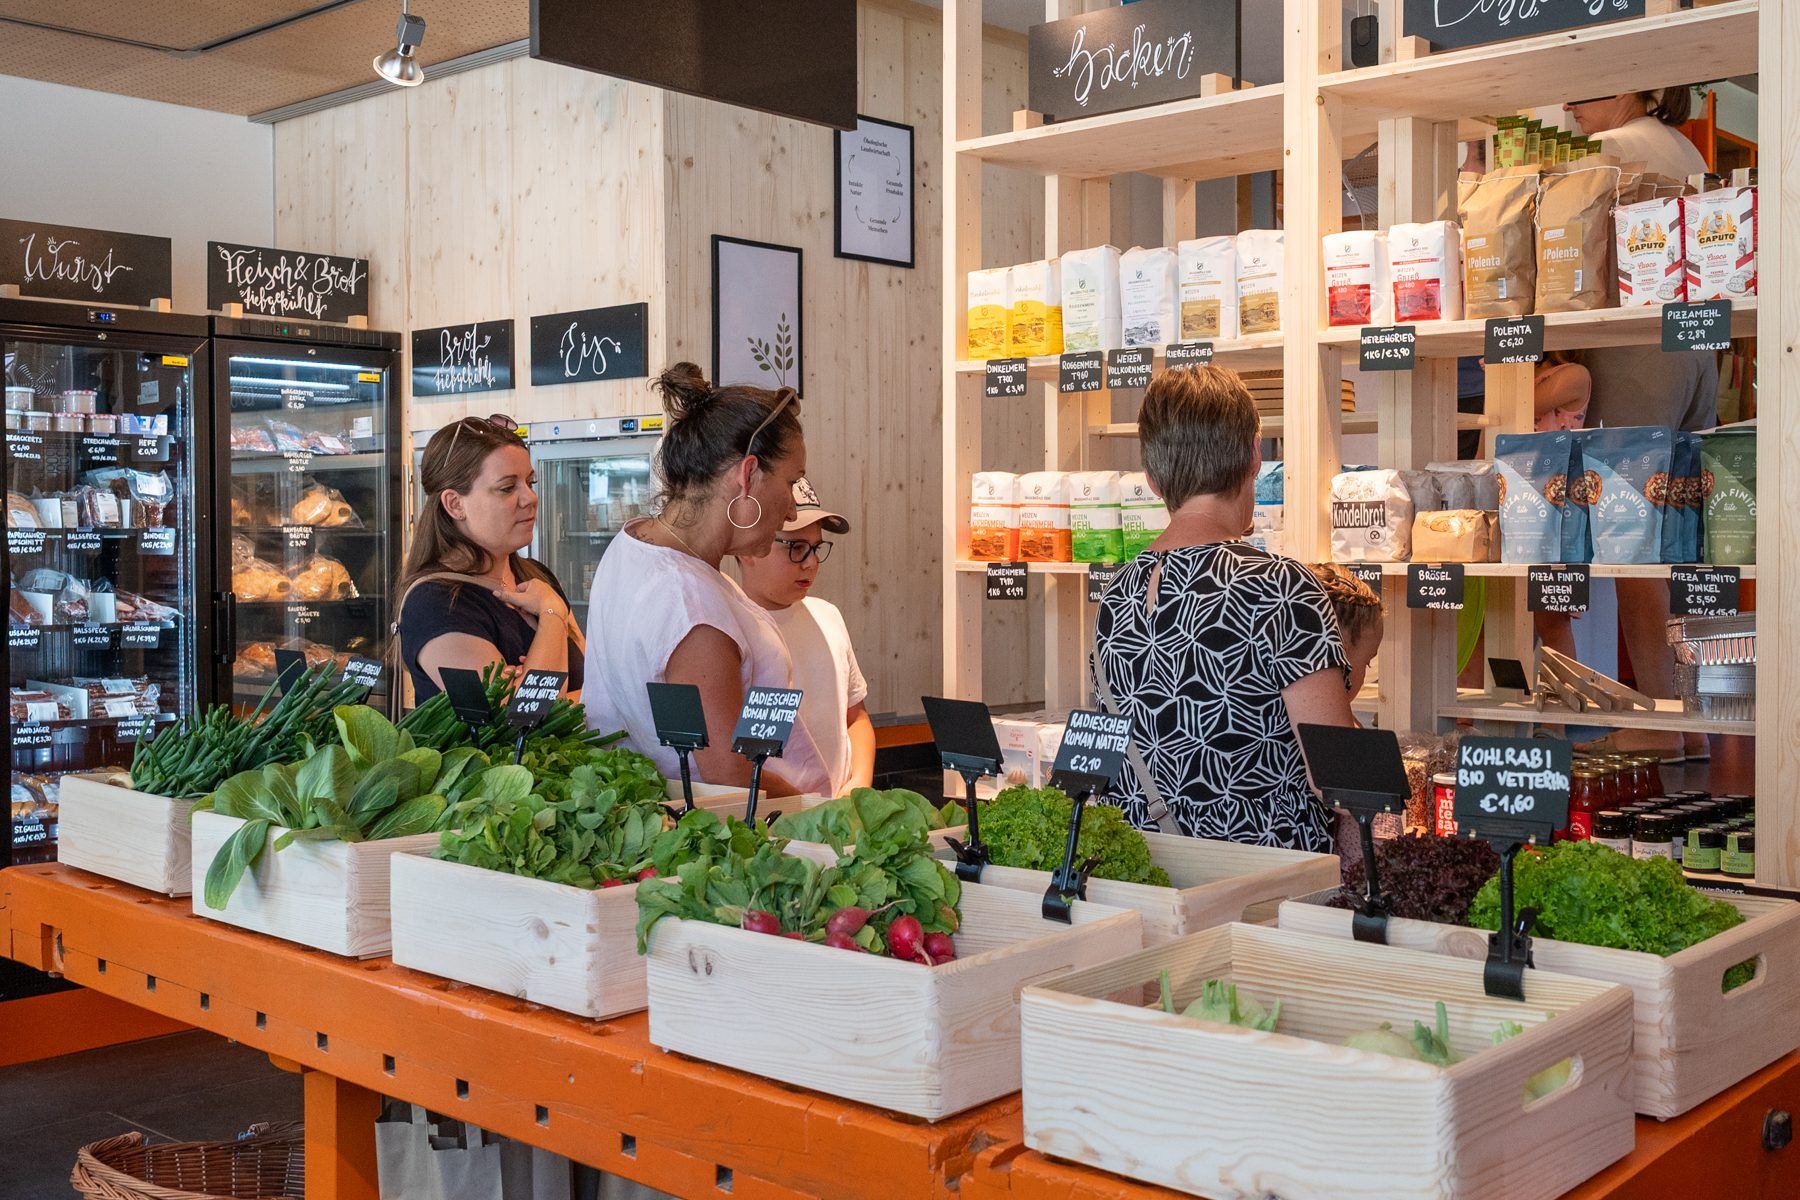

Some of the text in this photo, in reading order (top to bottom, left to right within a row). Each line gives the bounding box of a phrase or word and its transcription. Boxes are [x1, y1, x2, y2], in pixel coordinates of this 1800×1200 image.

[1699, 233, 1735, 244] CAPUTO
[1546, 246, 1579, 260] Polenta
[1629, 242, 1665, 253] CAPUTO
[20, 233, 133, 293] Wurst
[1470, 255, 1501, 268] Polenta
[218, 245, 366, 296] Fleisch & Brot
[1667, 309, 1721, 320] PIZZAMEHL
[1493, 325, 1532, 337] POLENTA
[440, 323, 491, 370] Brot
[560, 321, 622, 378] Eis
[1062, 359, 1101, 370] ROGGENMEHL
[1116, 353, 1142, 364] WEIZEN
[986, 363, 1027, 374] DINKELMEHL
[1107, 364, 1152, 376] VOLLKORNMEHL
[997, 374, 1013, 384] T700
[1071, 370, 1089, 381] T960
[1109, 376, 1147, 387] 1KG €1,99
[986, 385, 999, 395] 1KG
[1062, 382, 1075, 391] 1KG
[1503, 492, 1547, 518] PIZZA FINITO
[1598, 490, 1647, 518] PIZZA FINITO
[1708, 488, 1756, 516] PIZZA FINITO
[1333, 503, 1385, 528] Knödelbrot
[1072, 521, 1094, 531] MEHL
[1124, 521, 1148, 531] MEHL
[987, 567, 1026, 576] KUCHENMEHL
[1418, 570, 1452, 581] BRÖSEL
[1530, 571, 1585, 583] PIZZA FINITO
[1672, 571, 1737, 584] PIZZA FINITO
[988, 587, 1000, 597] 1KG
[1541, 584, 1572, 595] WEIZEN
[1687, 583, 1721, 593] DINKEL
[9, 629, 40, 637] USSALAMI
[74, 626, 107, 635] HALSSPECK
[525, 673, 559, 687] PAK CHOI
[748, 690, 802, 708] RADIESCHEN
[742, 705, 797, 724] ROMAN NATTER
[1070, 712, 1132, 735] RADIESCHEN
[1064, 728, 1130, 754] ROMAN NATTER
[1461, 745, 1552, 769] KOHLRABI
[1458, 768, 1485, 787] BIO
[1480, 793, 1535, 815] €1,60
